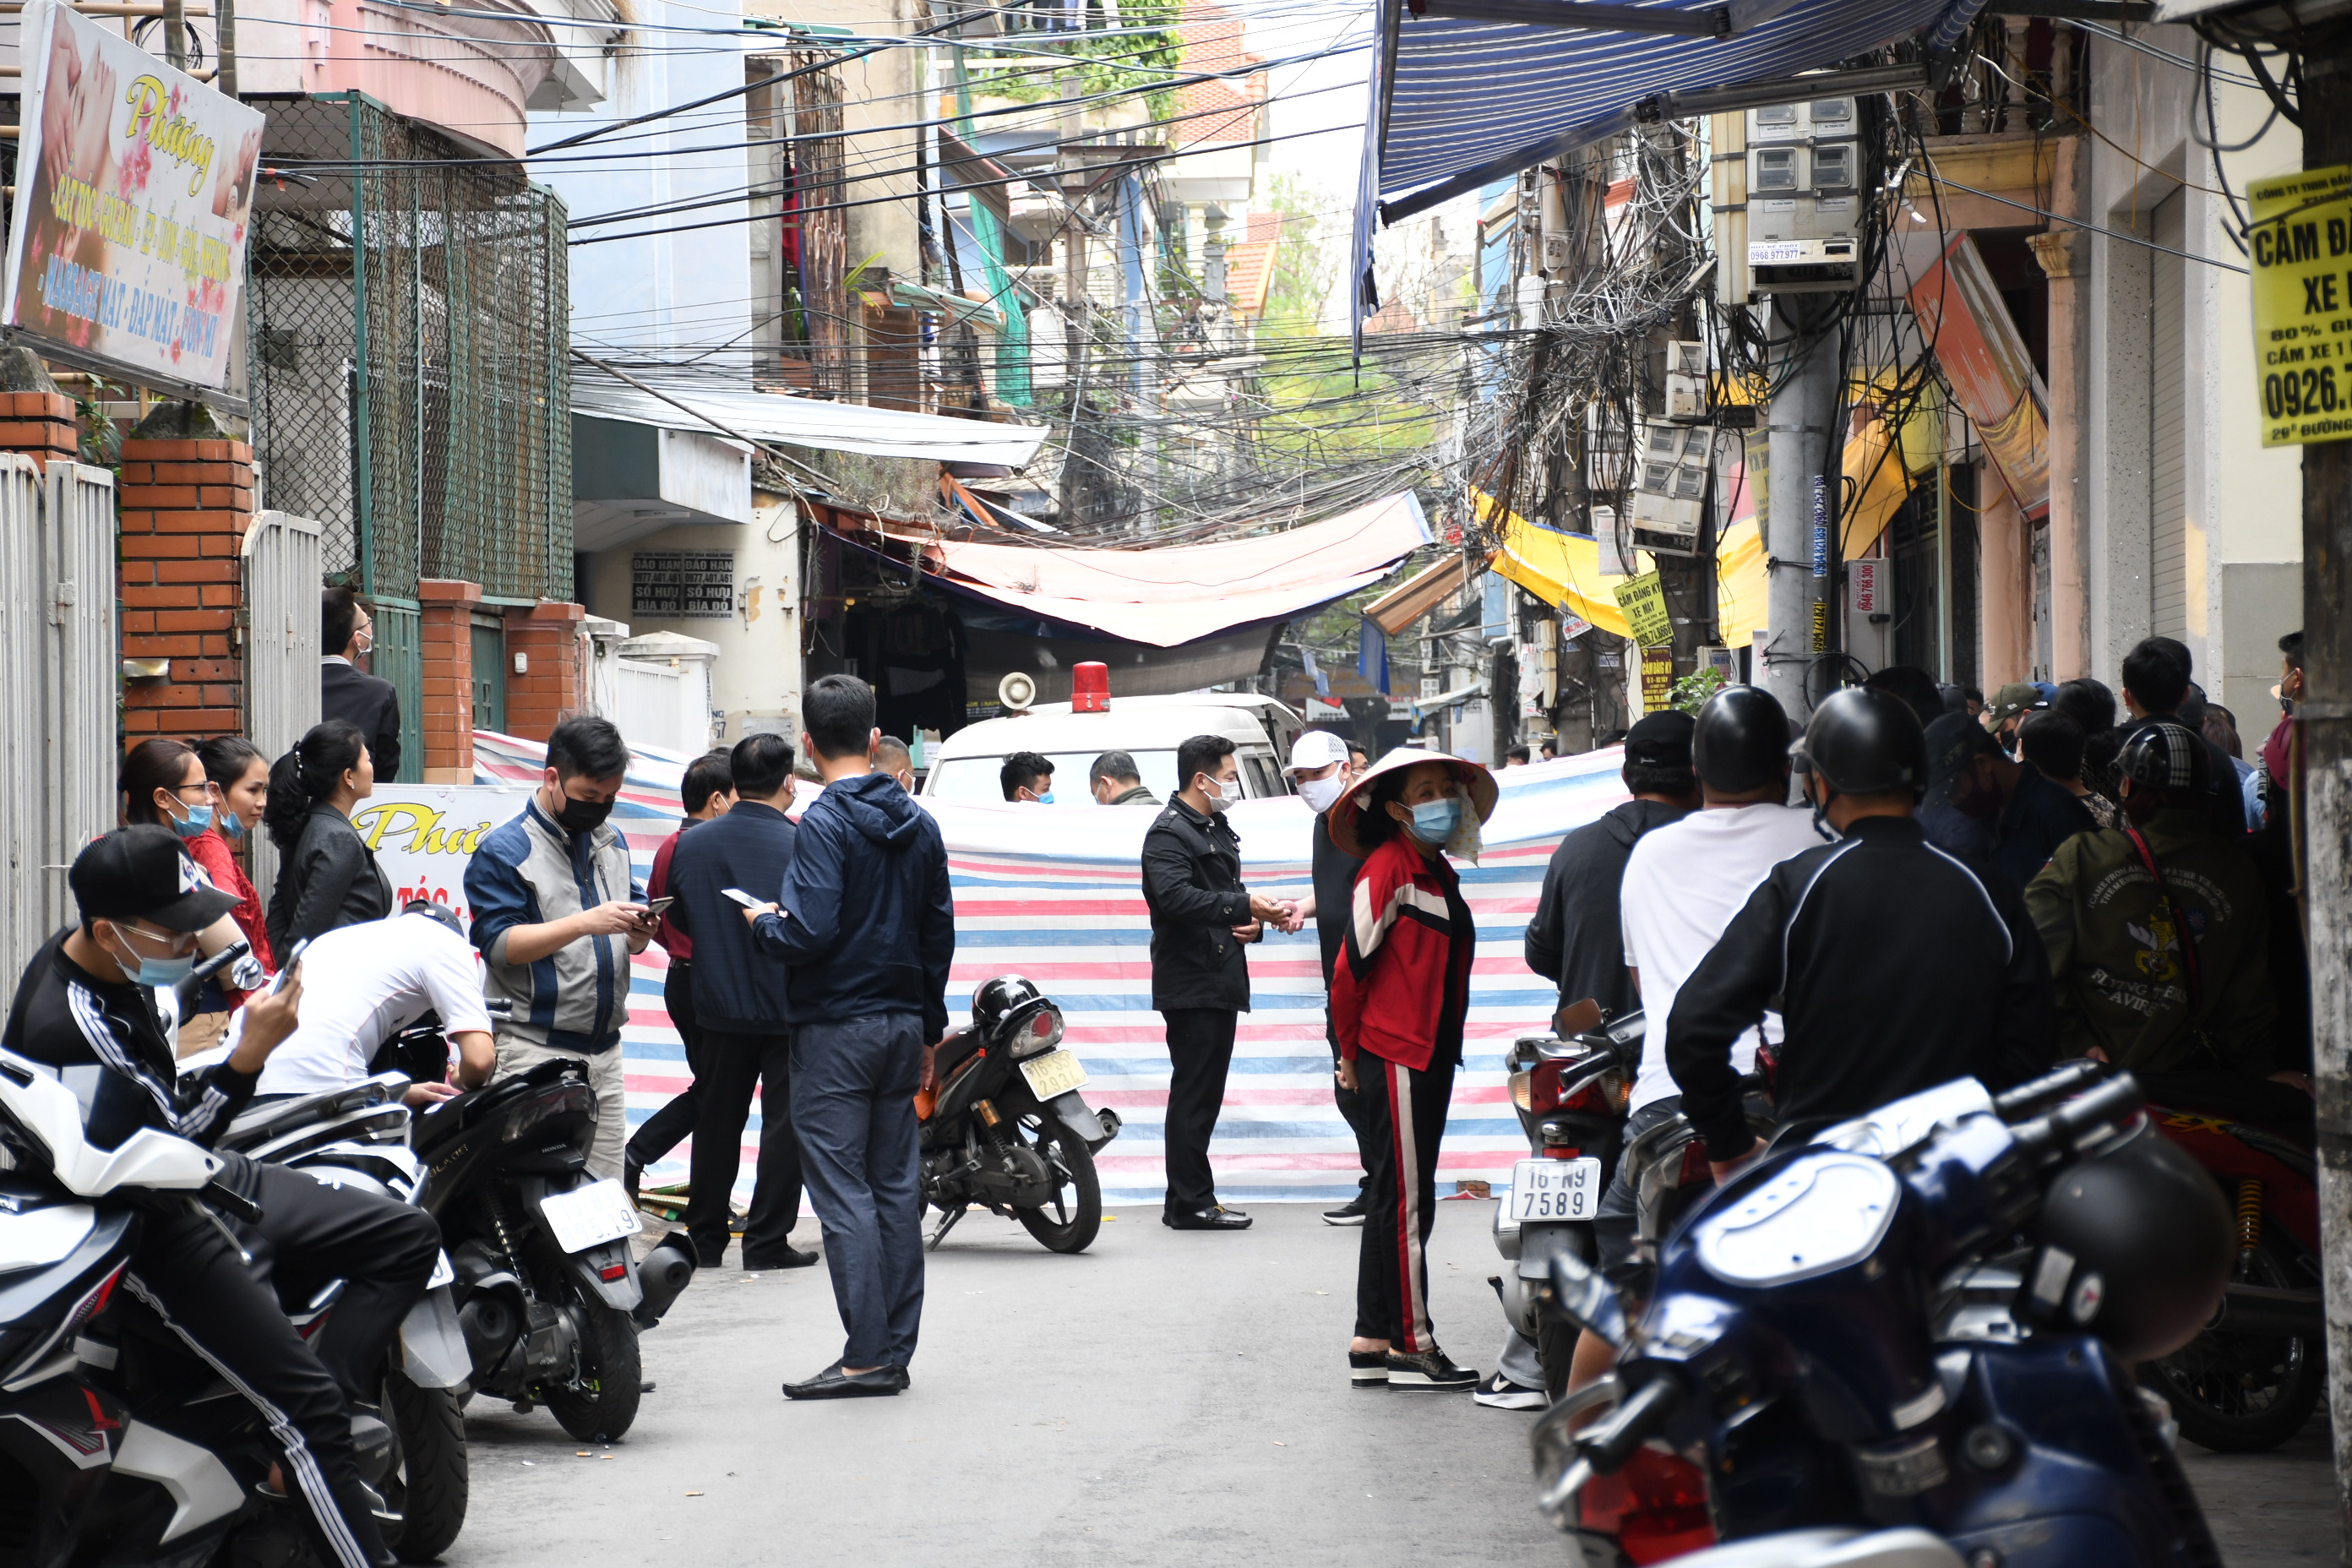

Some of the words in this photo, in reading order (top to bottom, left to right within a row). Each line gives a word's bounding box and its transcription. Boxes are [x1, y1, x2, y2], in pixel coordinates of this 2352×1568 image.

[126, 74, 215, 197] Phượng
[74, 170, 97, 231] TÓC
[42, 253, 101, 323] MASSAGE
[2303, 273, 2339, 315] XE
[2271, 324, 2322, 341] 80%
[2311, 343, 2331, 359] XE
[350, 803, 492, 855] Phư
[542, 1143, 568, 1154] HONDA
[1524, 1191, 1584, 1217] 7589
